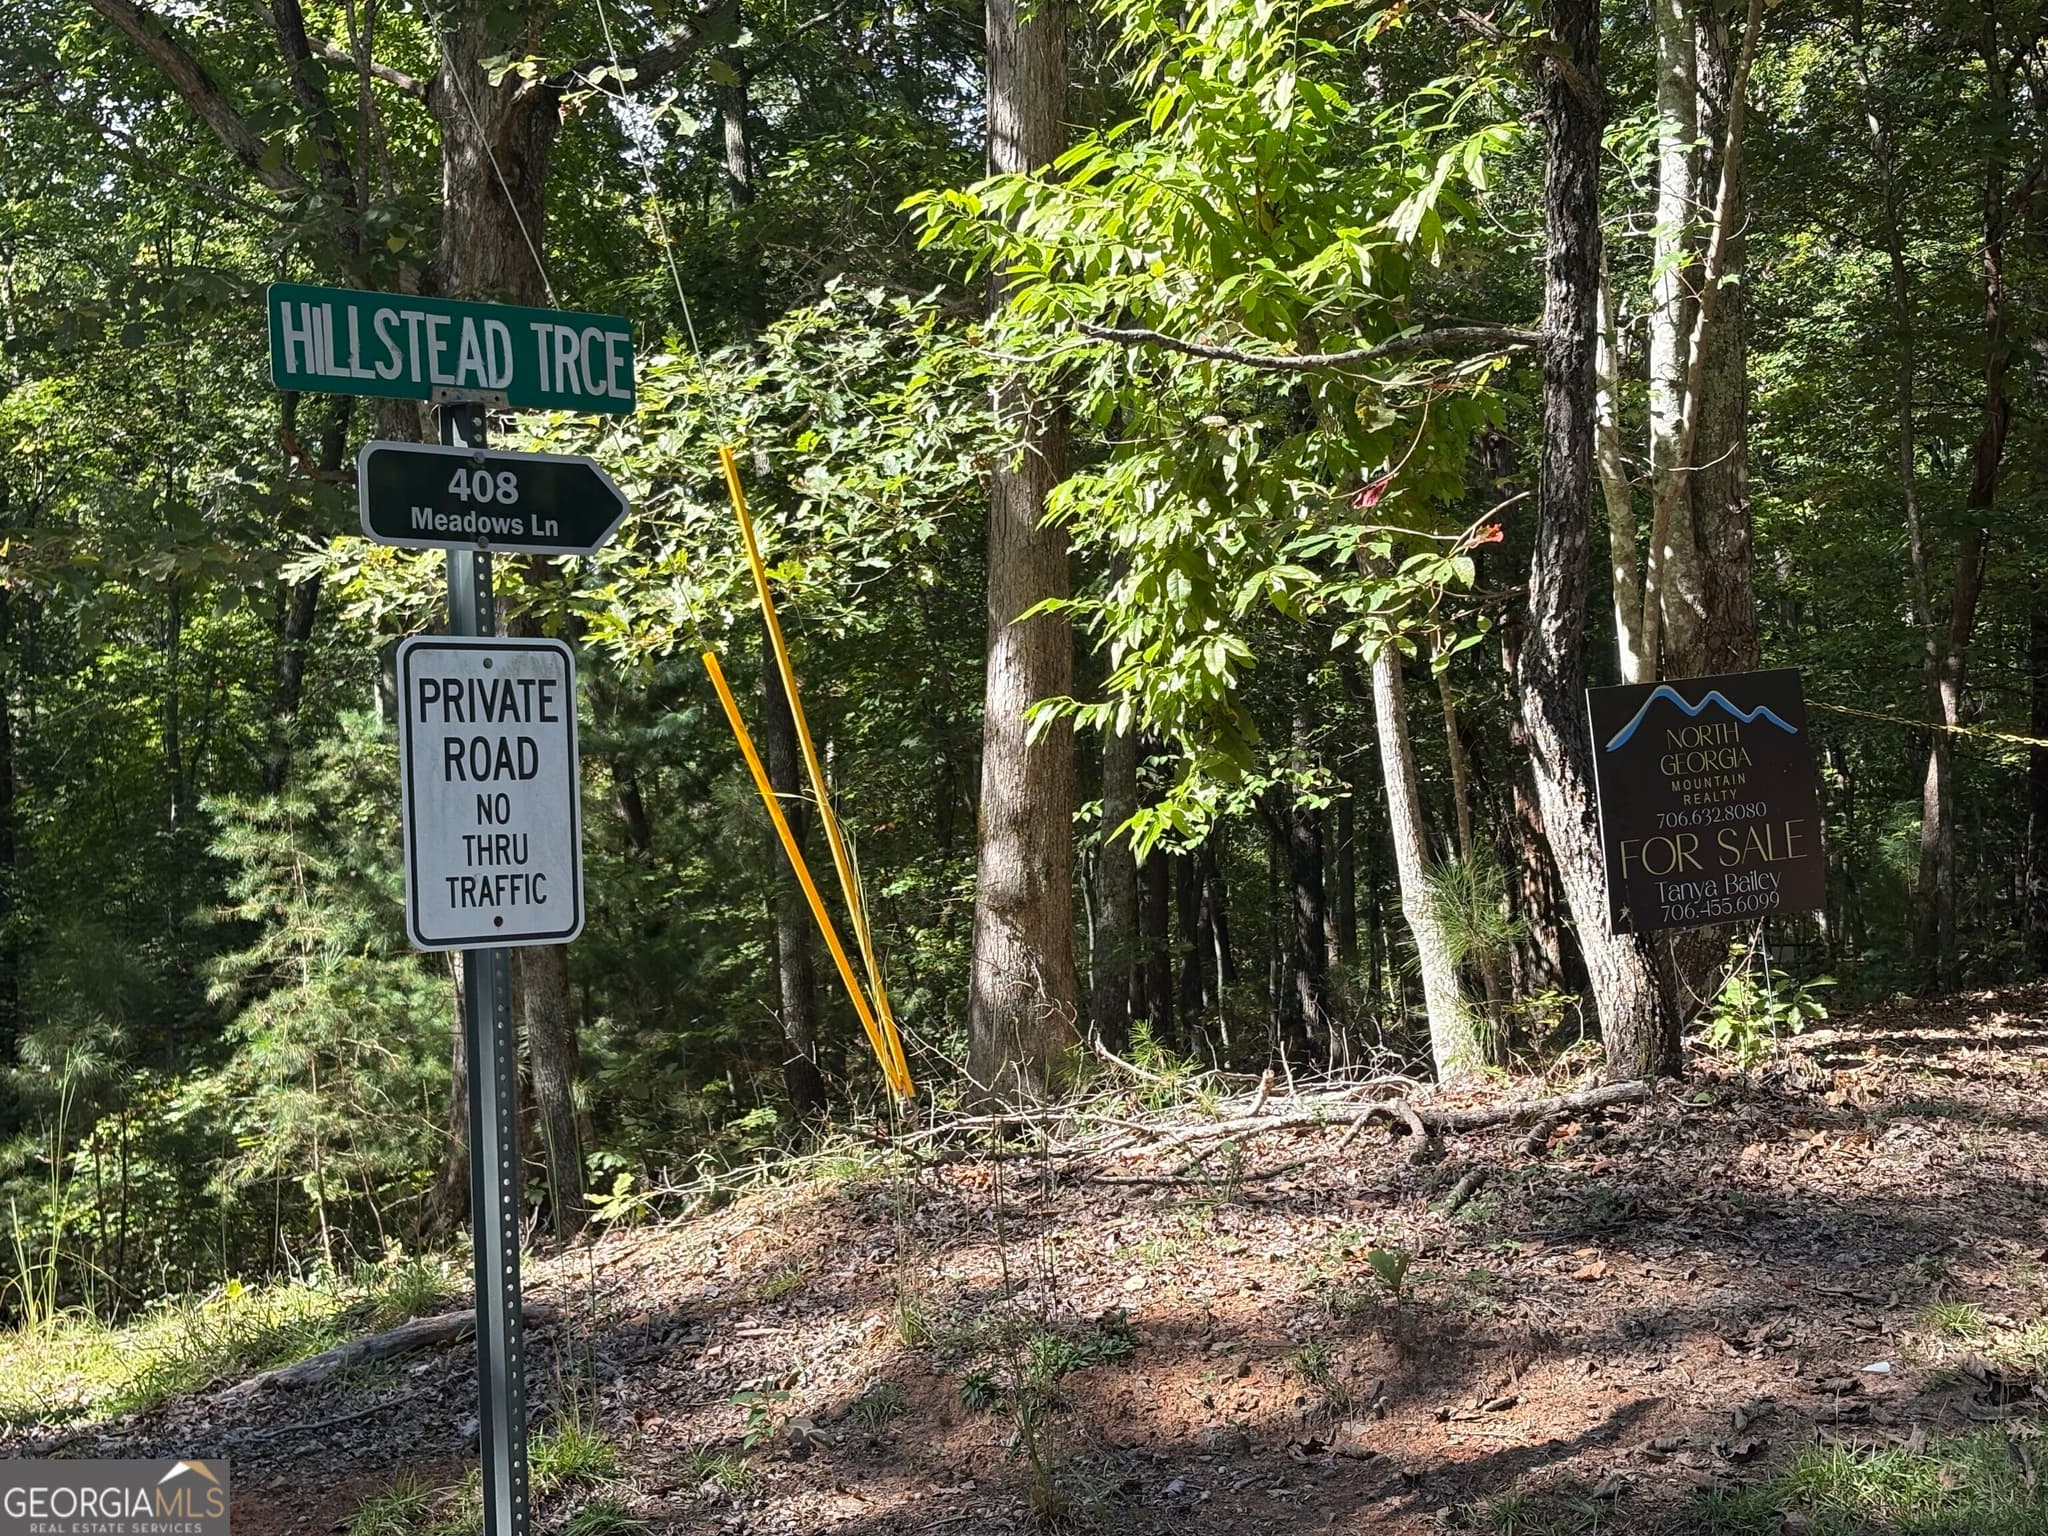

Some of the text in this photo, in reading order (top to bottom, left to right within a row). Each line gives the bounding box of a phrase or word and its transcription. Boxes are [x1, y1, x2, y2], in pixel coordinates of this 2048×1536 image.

[281, 301, 631, 399] HILLSTEAD TRCE
[448, 468, 519, 504] 408
[411, 506, 559, 537] Meadows Ln
[419, 678, 559, 723] PRIVATE
[1666, 721, 1740, 749] NORTH
[444, 736, 539, 782] ROAD
[1660, 746, 1753, 776] GEORGIA
[1671, 772, 1746, 792] MOUNTAIN
[1683, 788, 1737, 806] REALTY
[477, 792, 511, 825] NO
[1656, 801, 1767, 829] 706.632.8080
[462, 833, 529, 866] THRU
[1620, 819, 1808, 879] FOR SALE
[446, 872, 548, 909] TRAFFIC
[1655, 879, 1718, 904] Tanya
[1660, 891, 1780, 922] 706.455.6099
